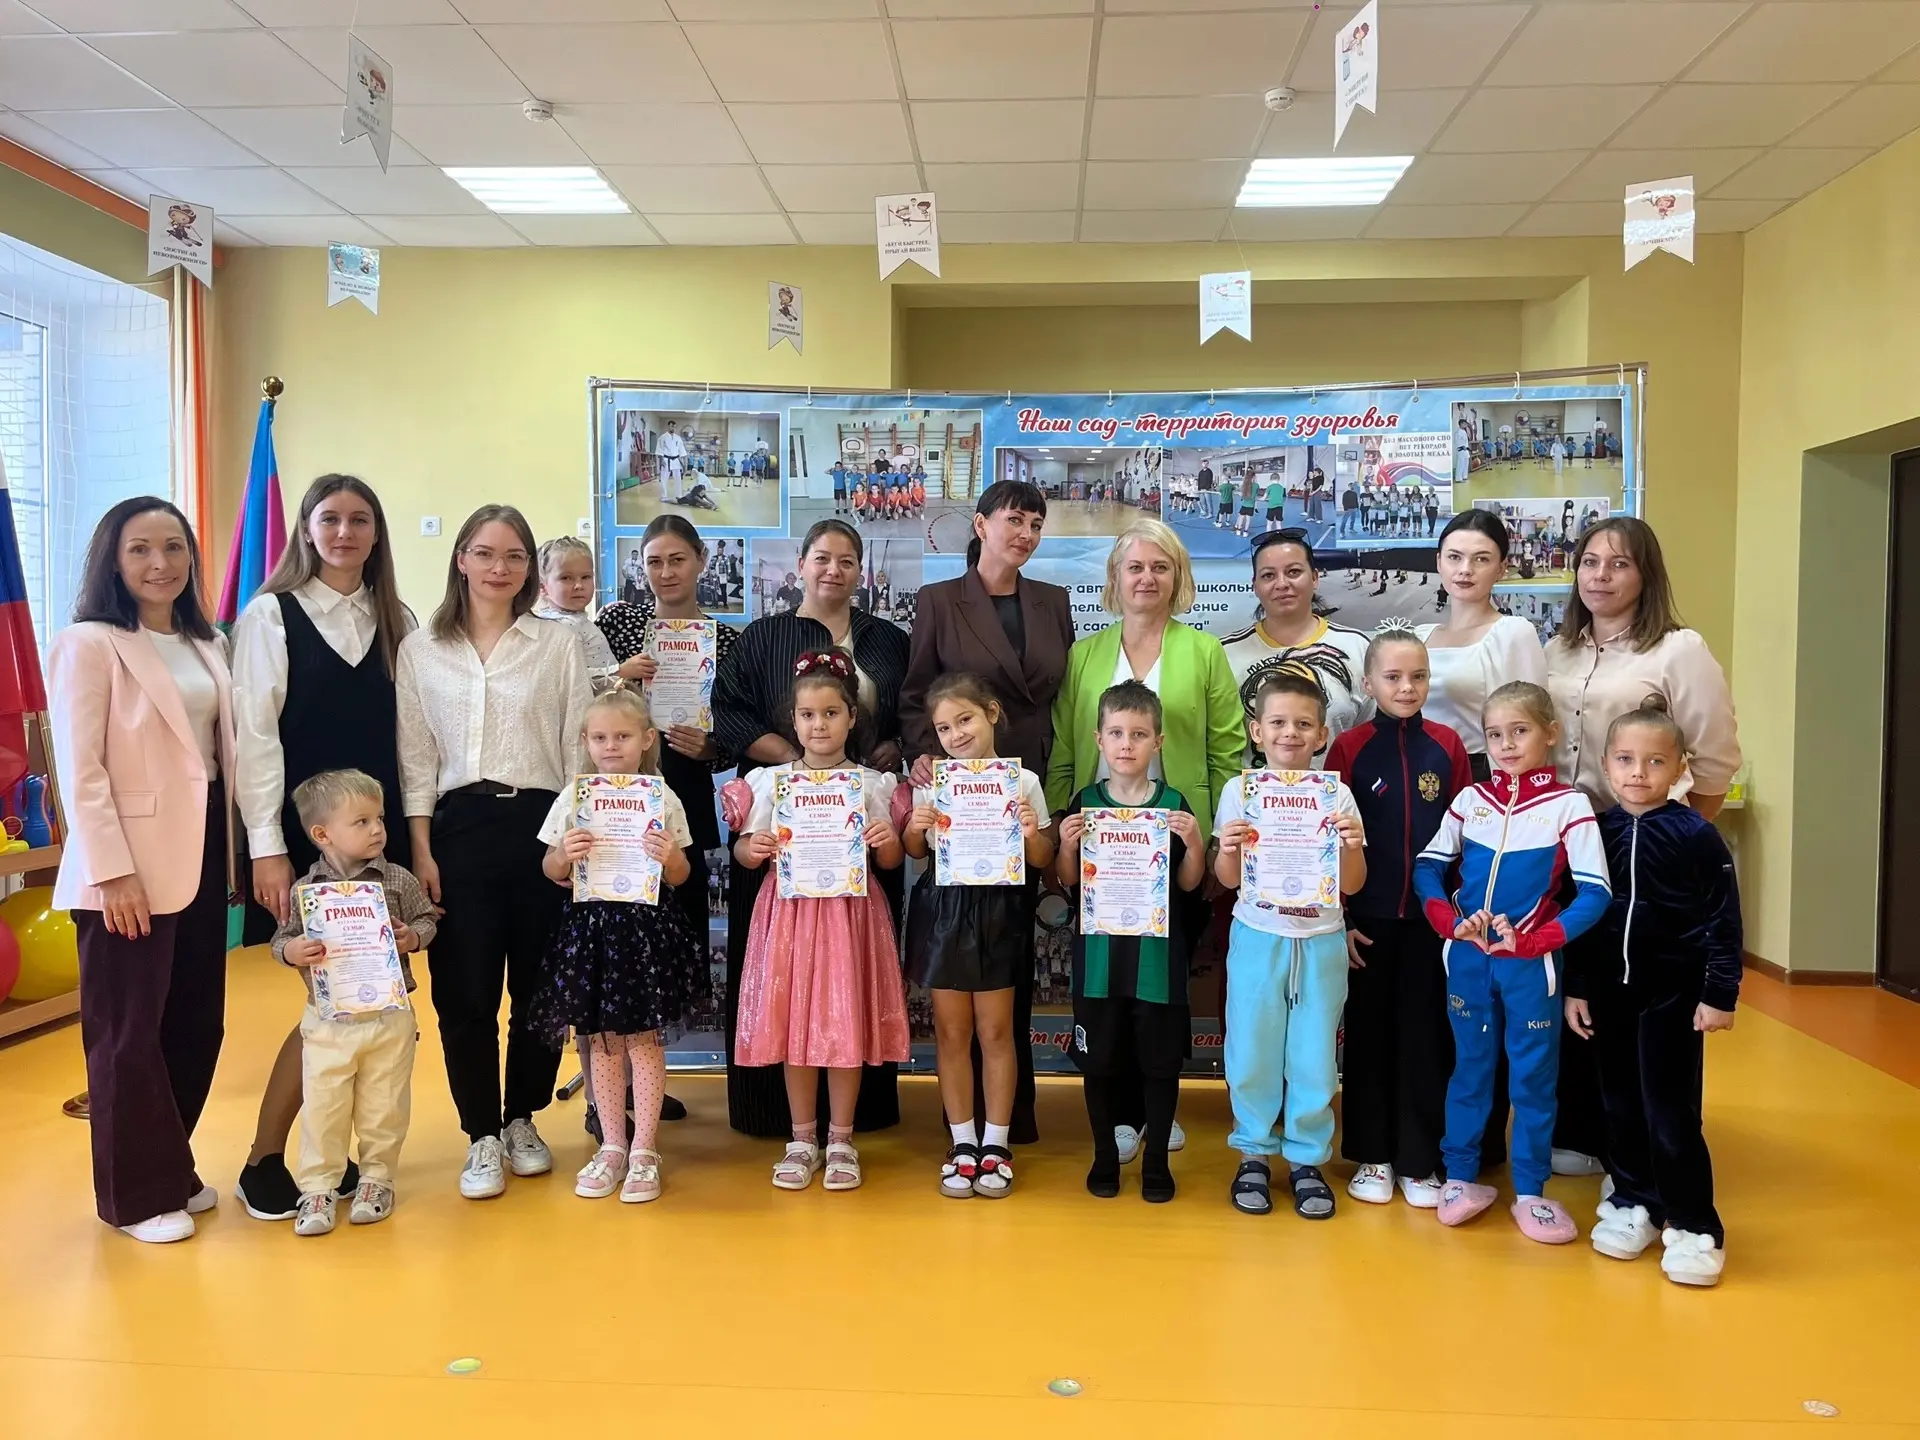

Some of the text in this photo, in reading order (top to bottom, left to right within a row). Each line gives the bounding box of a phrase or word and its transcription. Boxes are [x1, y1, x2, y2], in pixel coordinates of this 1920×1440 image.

[1018, 407, 1071, 432] Наш
[1291, 405, 1400, 438] здоровья
[658, 641, 699, 652] ГРАМОТА
[953, 782, 1003, 796] ГРАМОТА
[594, 799, 645, 812] ГРАМОТА
[794, 794, 845, 808] ГРАМОТА
[1263, 796, 1318, 810] ГРАМОТА
[1527, 813, 1551, 825] Kira
[1100, 832, 1150, 845] ГРАМОТА
[324, 906, 376, 922] ГРАМОТА
[1527, 1020, 1552, 1029] Kira
